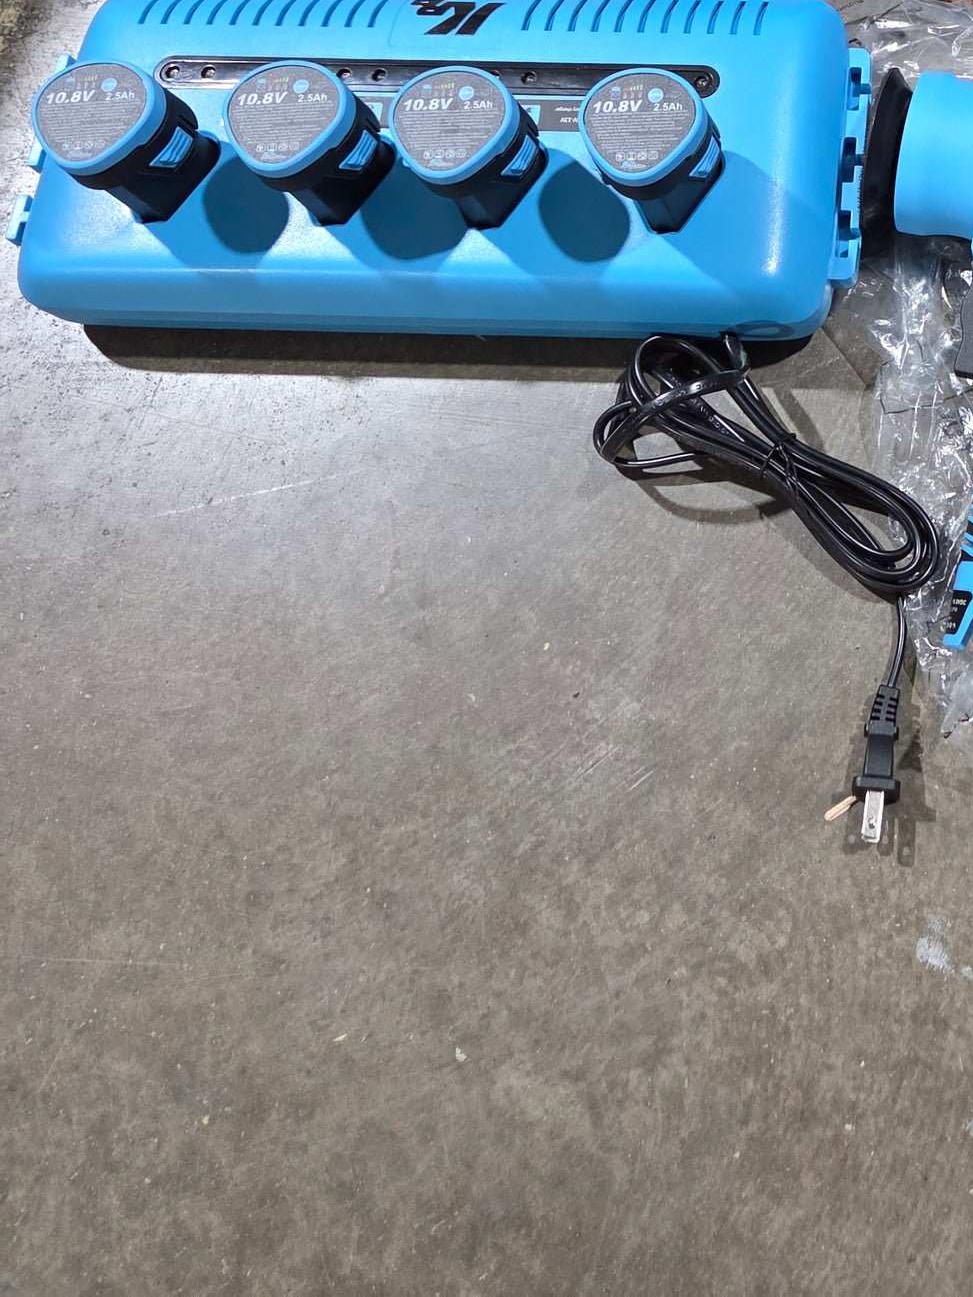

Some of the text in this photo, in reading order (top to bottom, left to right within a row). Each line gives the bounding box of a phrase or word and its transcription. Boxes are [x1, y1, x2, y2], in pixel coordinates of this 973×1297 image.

[46, 90, 135, 104] 10.8V 2.5Ah
[238, 92, 328, 106] 10.8V 2.5Ah
[403, 98, 493, 111] 10.8V 2.5Ah
[593, 99, 643, 113] 10.8V
[653, 102, 683, 111] 2.5Ah
